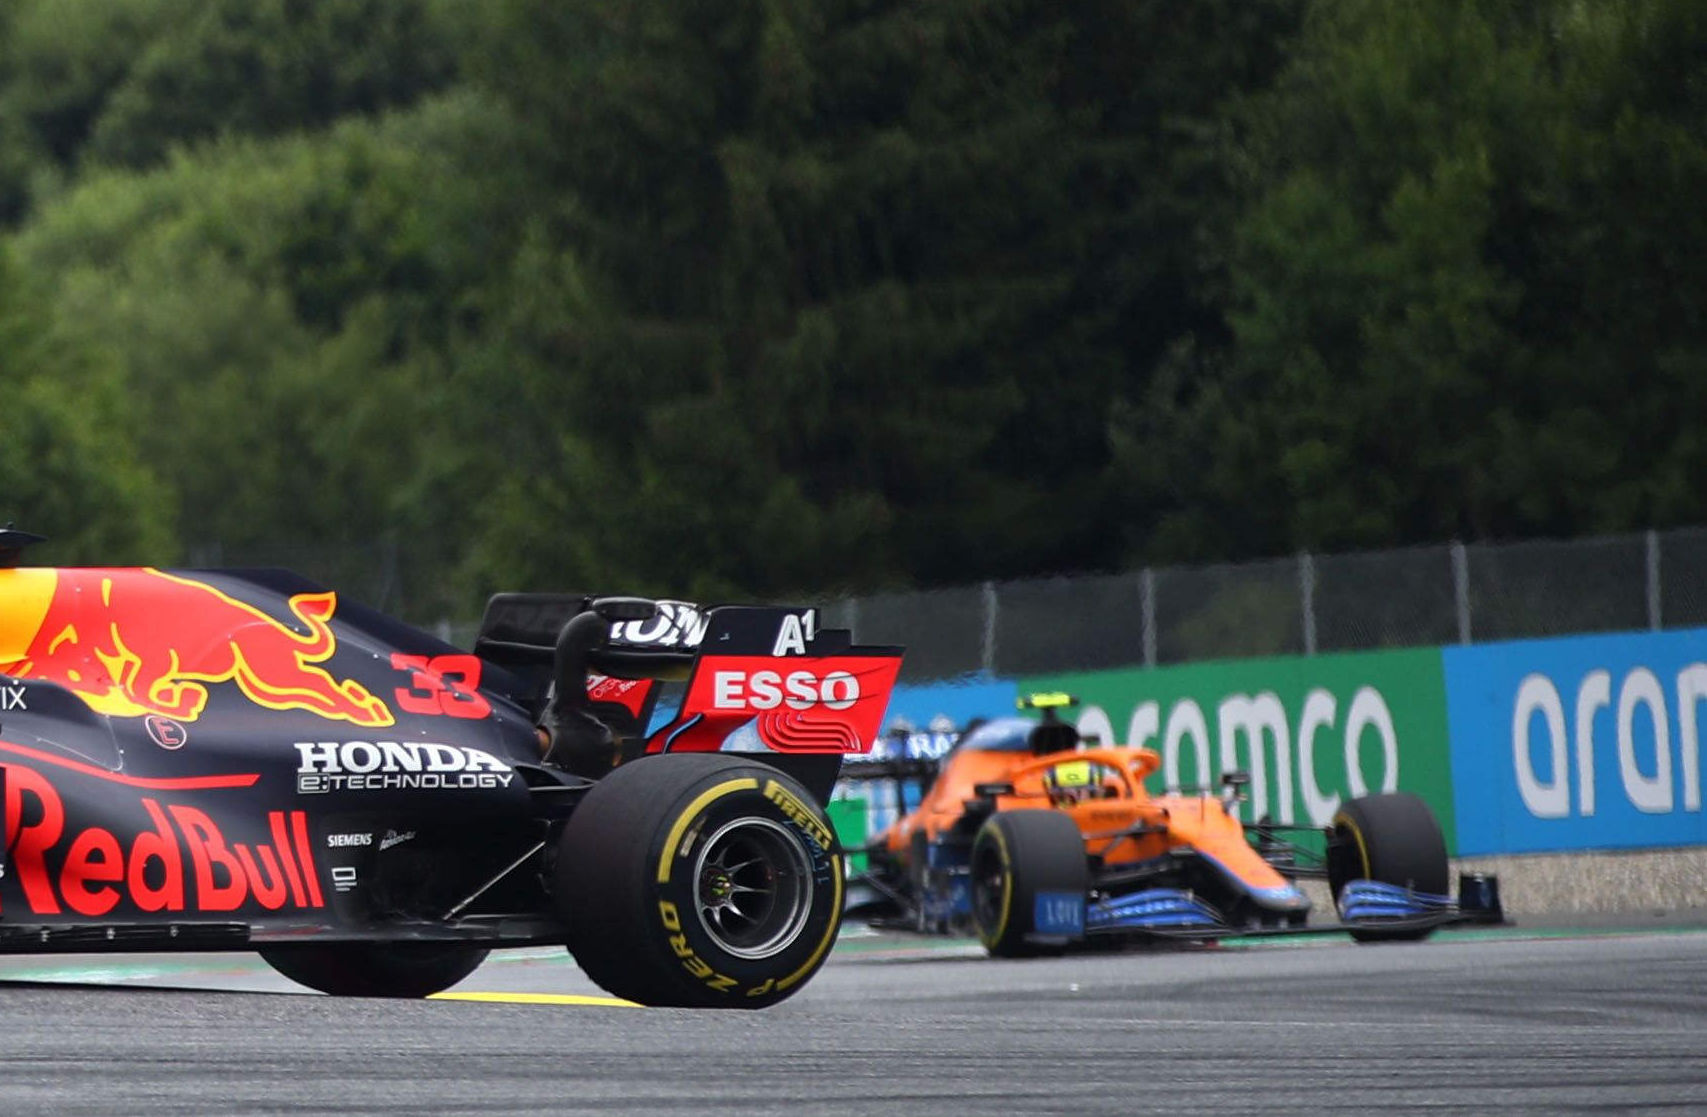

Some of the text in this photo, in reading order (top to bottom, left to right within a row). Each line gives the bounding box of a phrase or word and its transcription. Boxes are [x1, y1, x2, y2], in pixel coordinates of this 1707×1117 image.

[714, 670, 860, 710] ESSO
[294, 741, 512, 773] HONDA
[763, 779, 833, 851] PIRELLI
[327, 833, 372, 848] SIEMENS
[658, 899, 739, 992] ZERO
